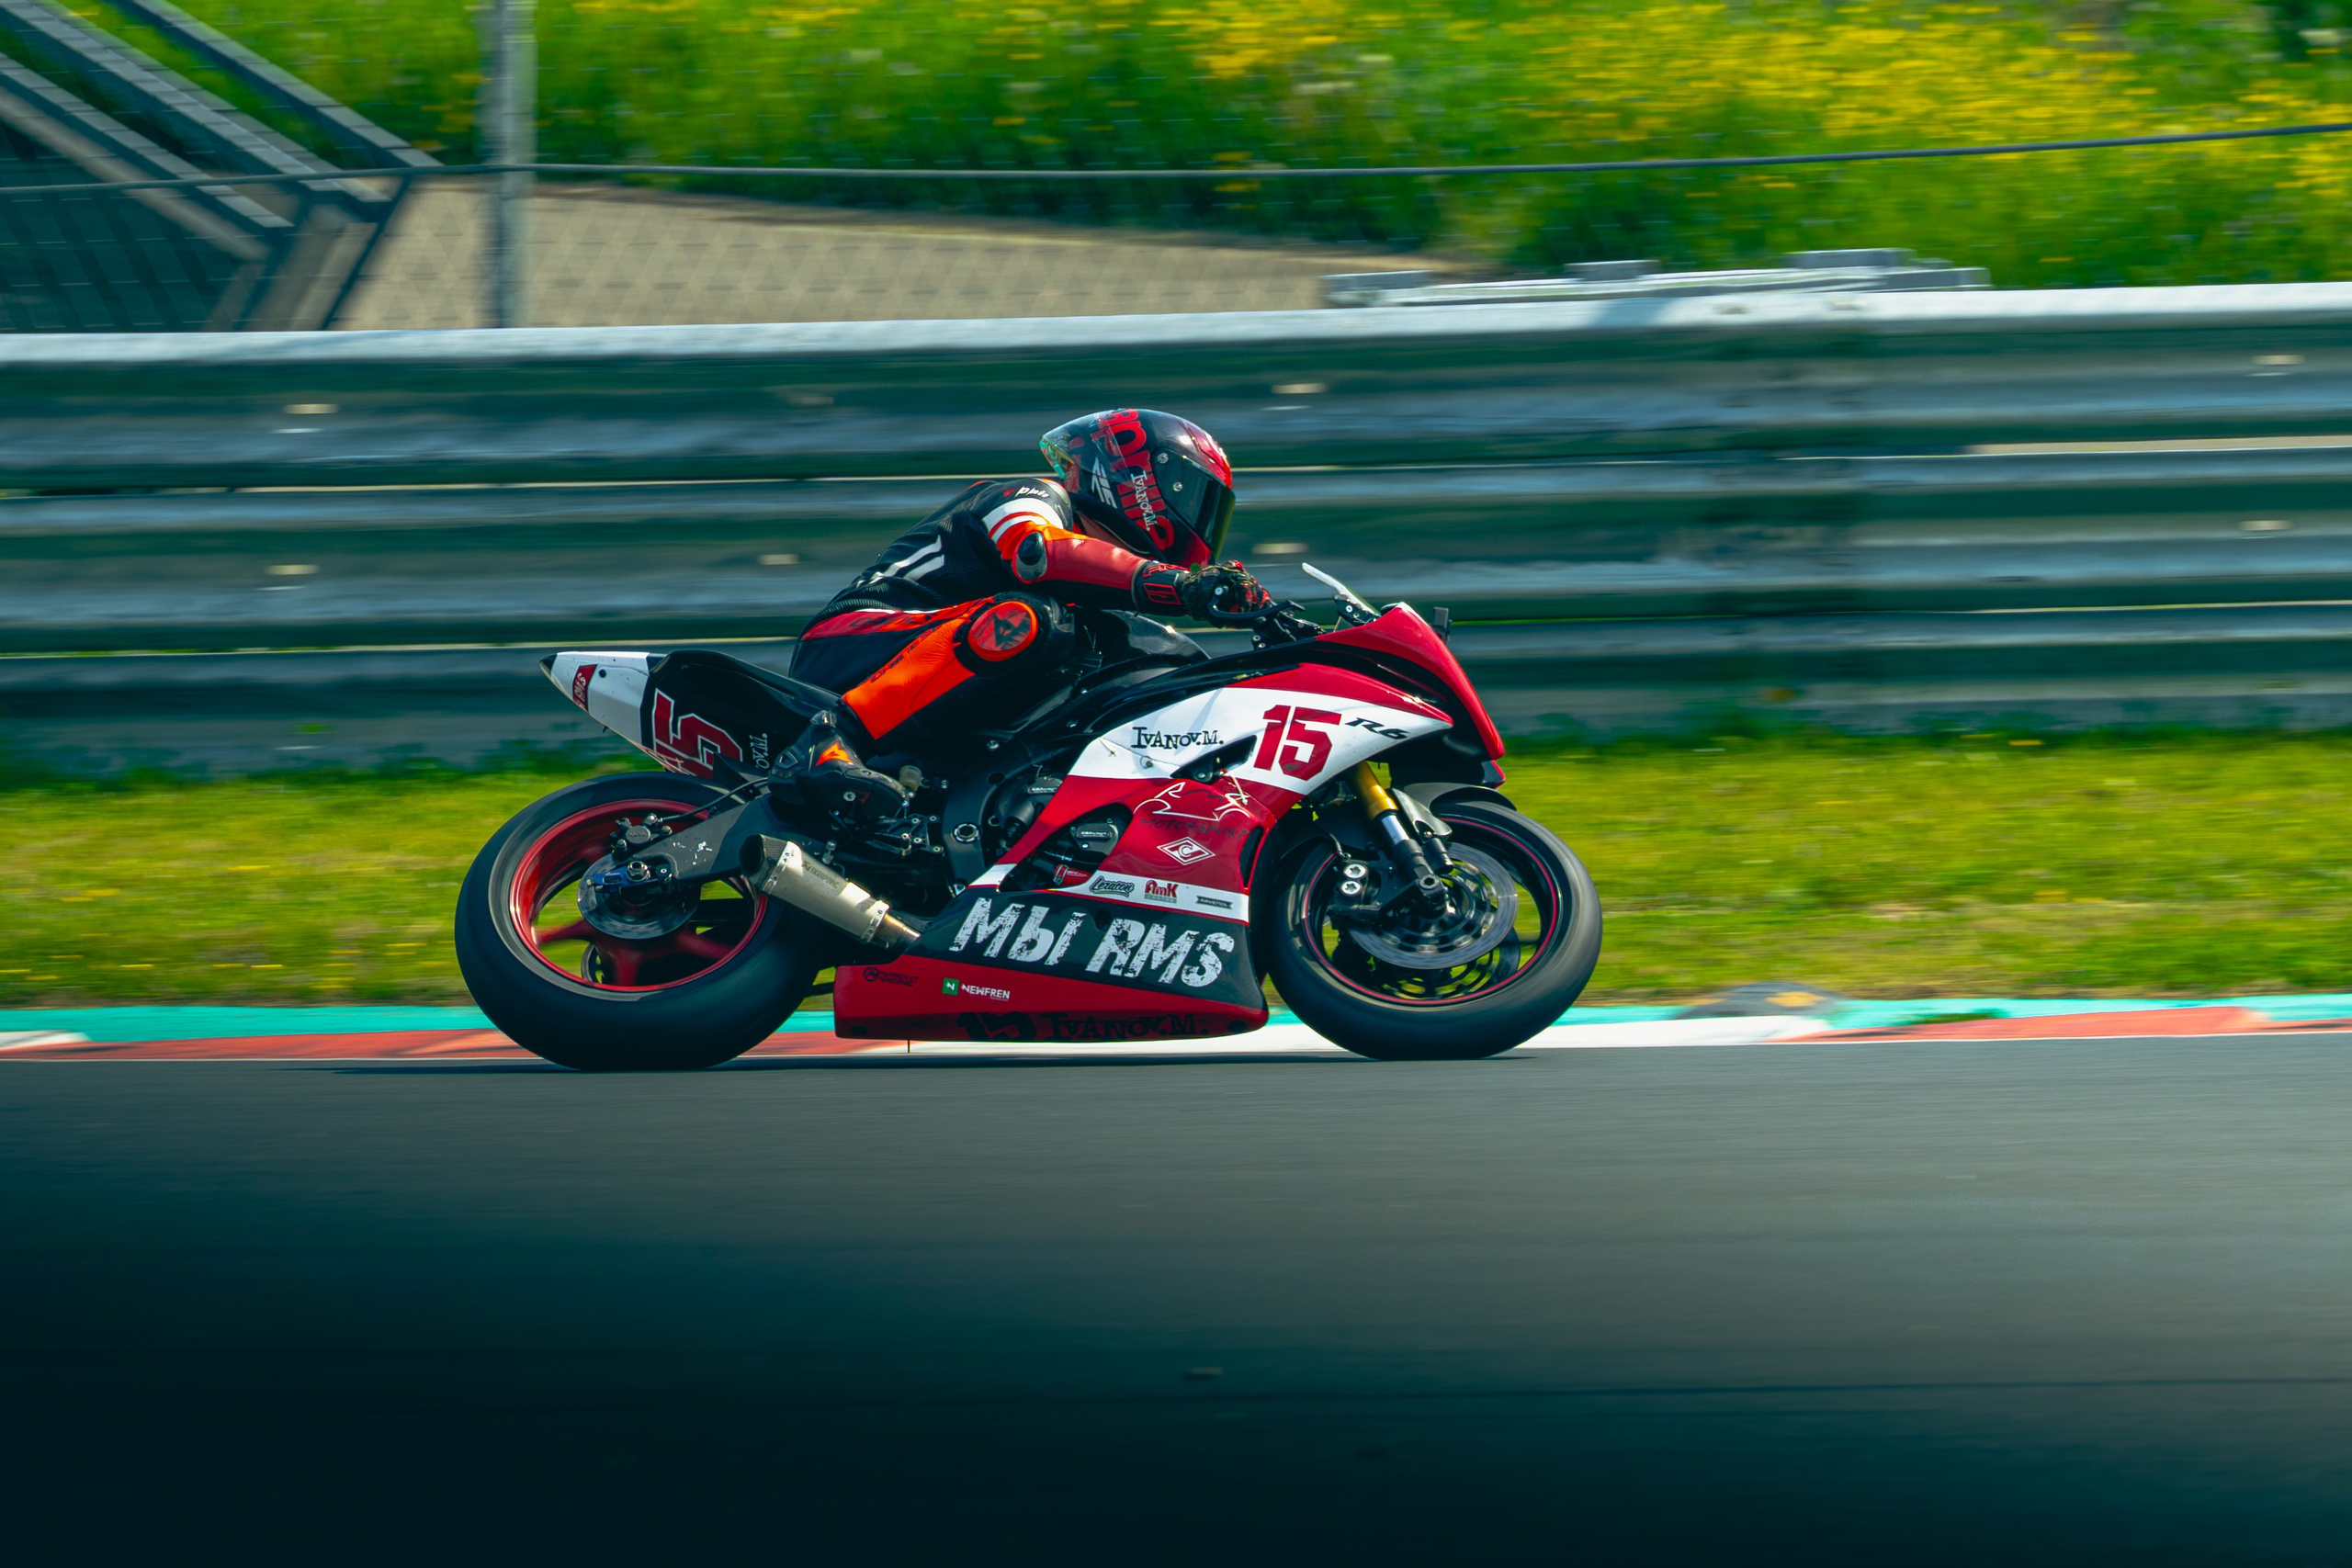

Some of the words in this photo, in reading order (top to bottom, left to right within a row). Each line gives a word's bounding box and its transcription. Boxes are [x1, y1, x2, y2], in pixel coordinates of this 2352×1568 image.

[1253, 705, 1342, 781] 15
[1344, 716, 1411, 740] R6
[1138, 818, 1250, 840] MOTORSPORT
[1085, 919, 1235, 987] RMS
[961, 983, 1011, 999] NEWFREN
